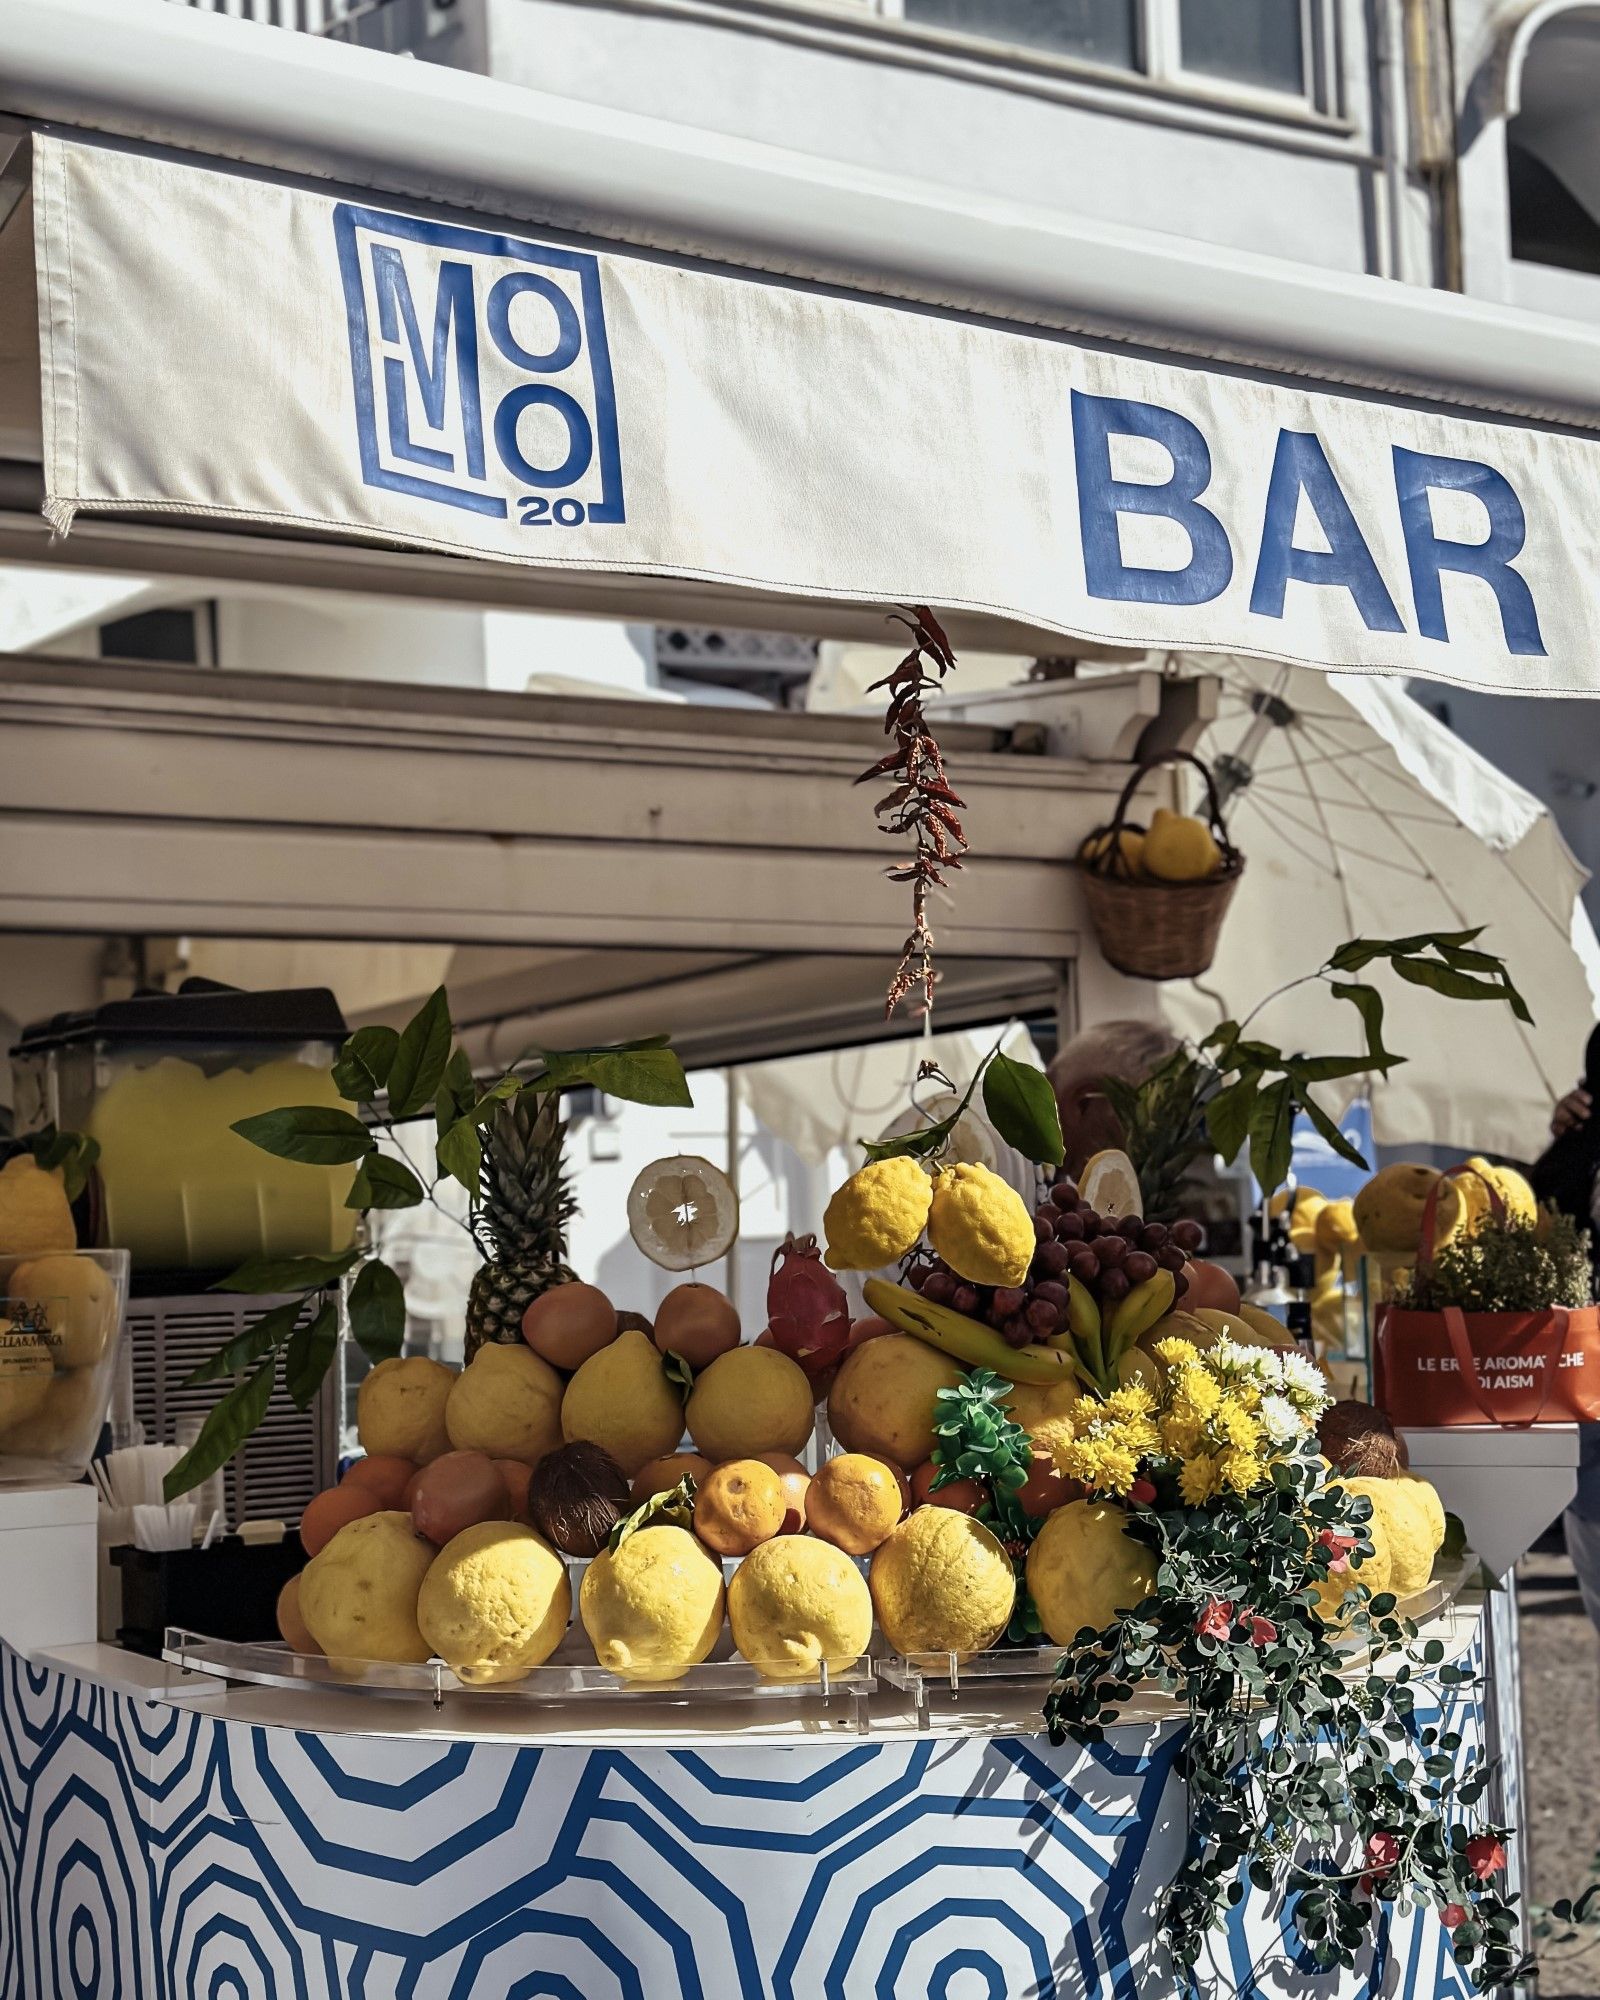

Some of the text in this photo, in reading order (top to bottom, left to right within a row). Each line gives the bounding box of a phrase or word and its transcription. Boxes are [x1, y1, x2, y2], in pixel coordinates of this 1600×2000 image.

[516, 496, 586, 526] 20
[1070, 388, 1549, 656] BAR
[1417, 1357, 1437, 1371] LE
[1440, 1357, 1481, 1371] ERE
[1493, 1375, 1534, 1389] AISM
